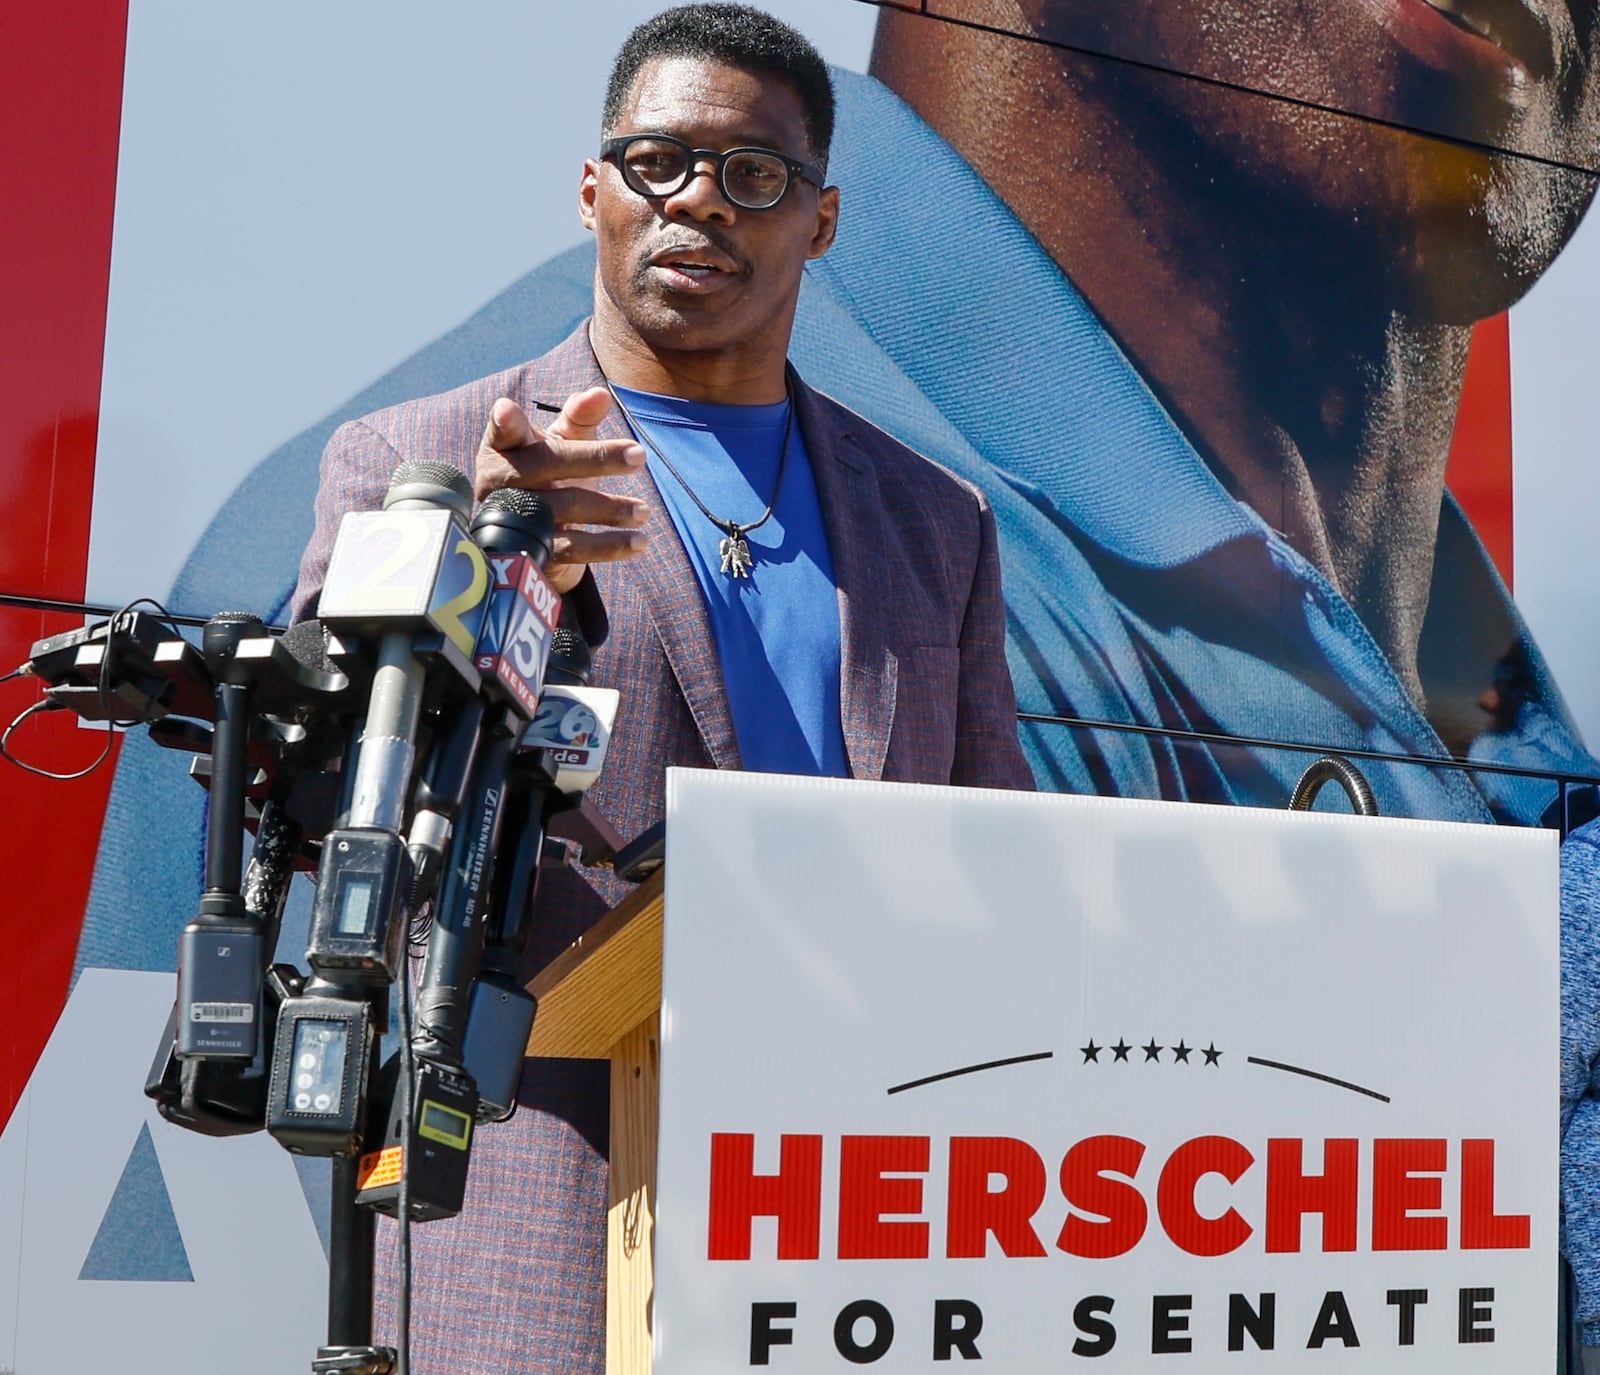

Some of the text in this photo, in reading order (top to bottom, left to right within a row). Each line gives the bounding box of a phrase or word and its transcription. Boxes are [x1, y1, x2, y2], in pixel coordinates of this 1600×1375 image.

[325, 512, 431, 611] 2
[524, 566, 558, 626] FOX
[428, 540, 488, 660] 2
[513, 608, 546, 679] 5
[501, 659, 536, 711] NEWS
[526, 698, 597, 744] 26
[470, 808, 493, 892] SENNHEISER
[196, 1039, 242, 1048] SENNHEISER
[708, 1133, 1531, 1261] HERSCHEL
[750, 1287, 1495, 1366] FOR SENATE
